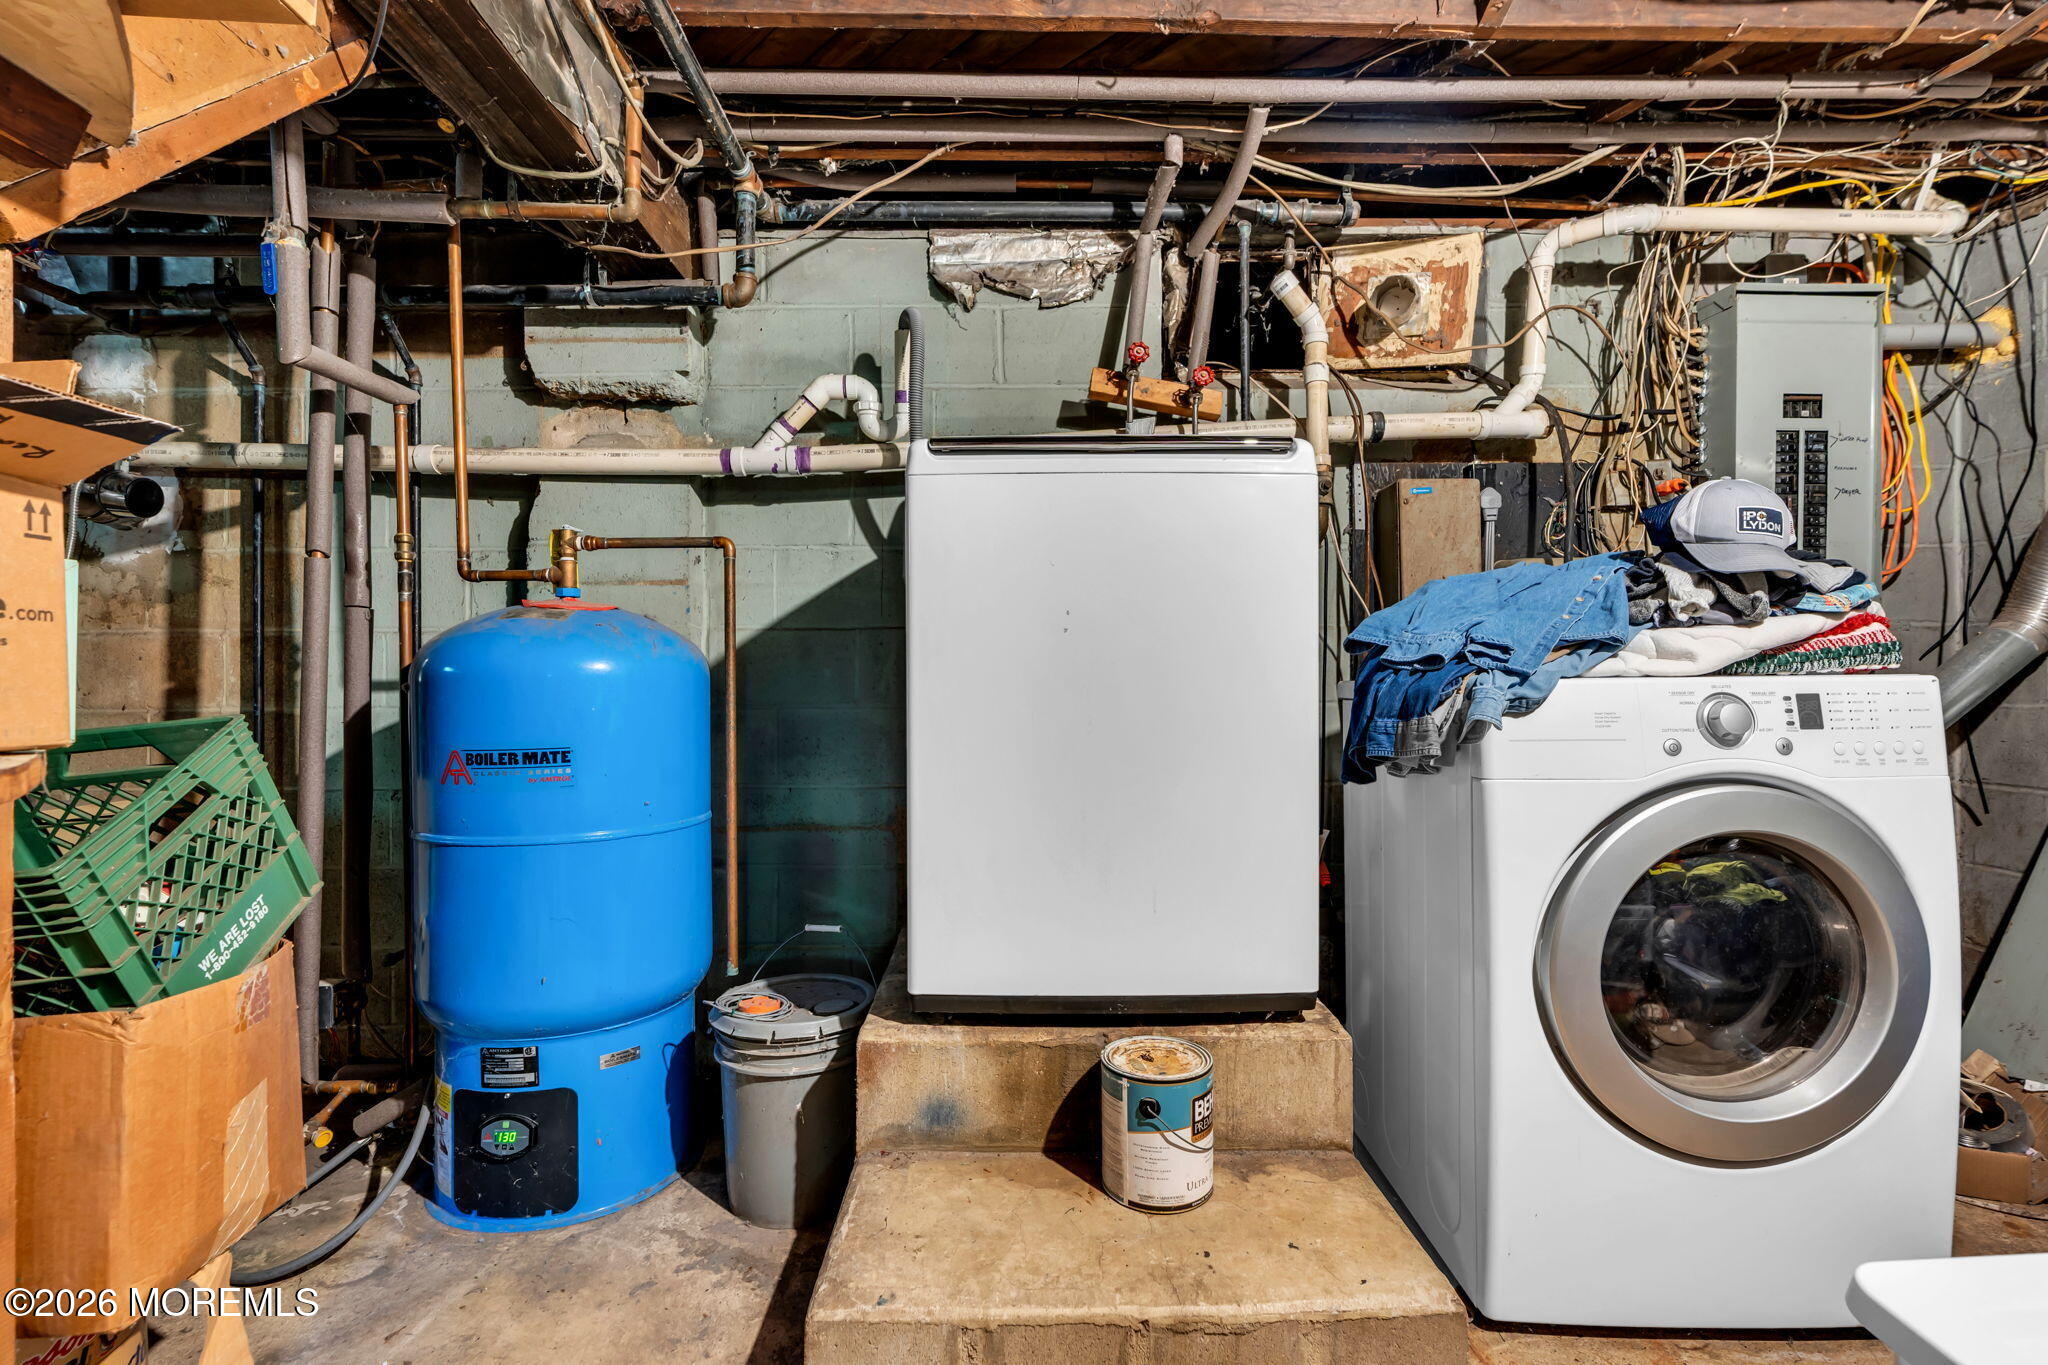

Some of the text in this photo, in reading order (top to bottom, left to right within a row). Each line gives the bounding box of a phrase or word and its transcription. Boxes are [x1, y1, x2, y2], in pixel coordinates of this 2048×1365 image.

[1743, 520, 1781, 532] LYDON
[465, 750, 572, 767] BOILER MATE
[527, 767, 572, 775] SERIES
[198, 893, 264, 972] WE ARE LOST
[204, 904, 269, 980] 1-800-452-9180
[497, 1131, 517, 1143] 130
